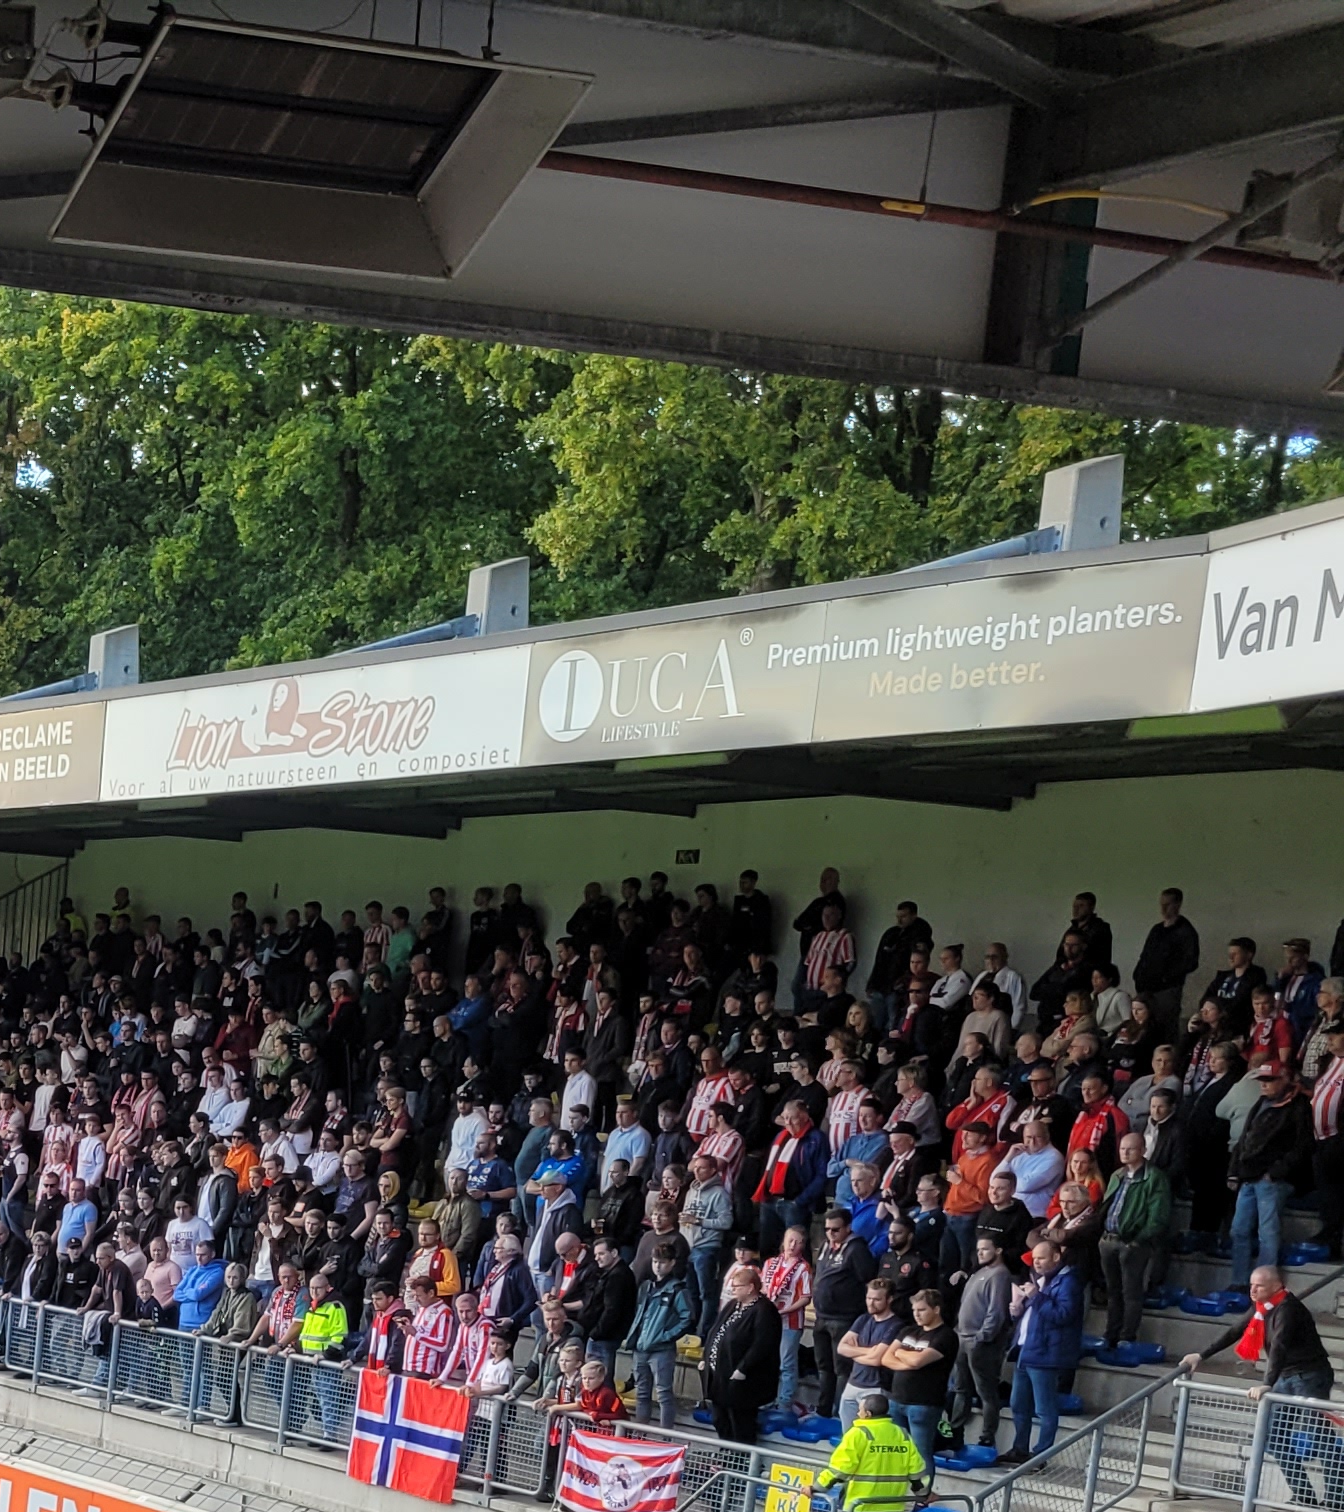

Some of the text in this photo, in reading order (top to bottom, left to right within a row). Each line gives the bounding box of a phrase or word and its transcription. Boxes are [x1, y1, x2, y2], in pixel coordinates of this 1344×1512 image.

[766, 602, 1183, 669] Premium lightweight planters.
[1213, 586, 1299, 660] Van
[868, 660, 1046, 698] Made better.
[166, 690, 436, 772] Lion Stone
[601, 720, 681, 743] LIFESTYLE
[13, 753, 70, 782] BEELD
[109, 778, 146, 798] Voor
[188, 775, 211, 791] uw
[227, 764, 338, 790] natuursteen
[357, 759, 378, 778] en
[398, 746, 511, 773] composiet
